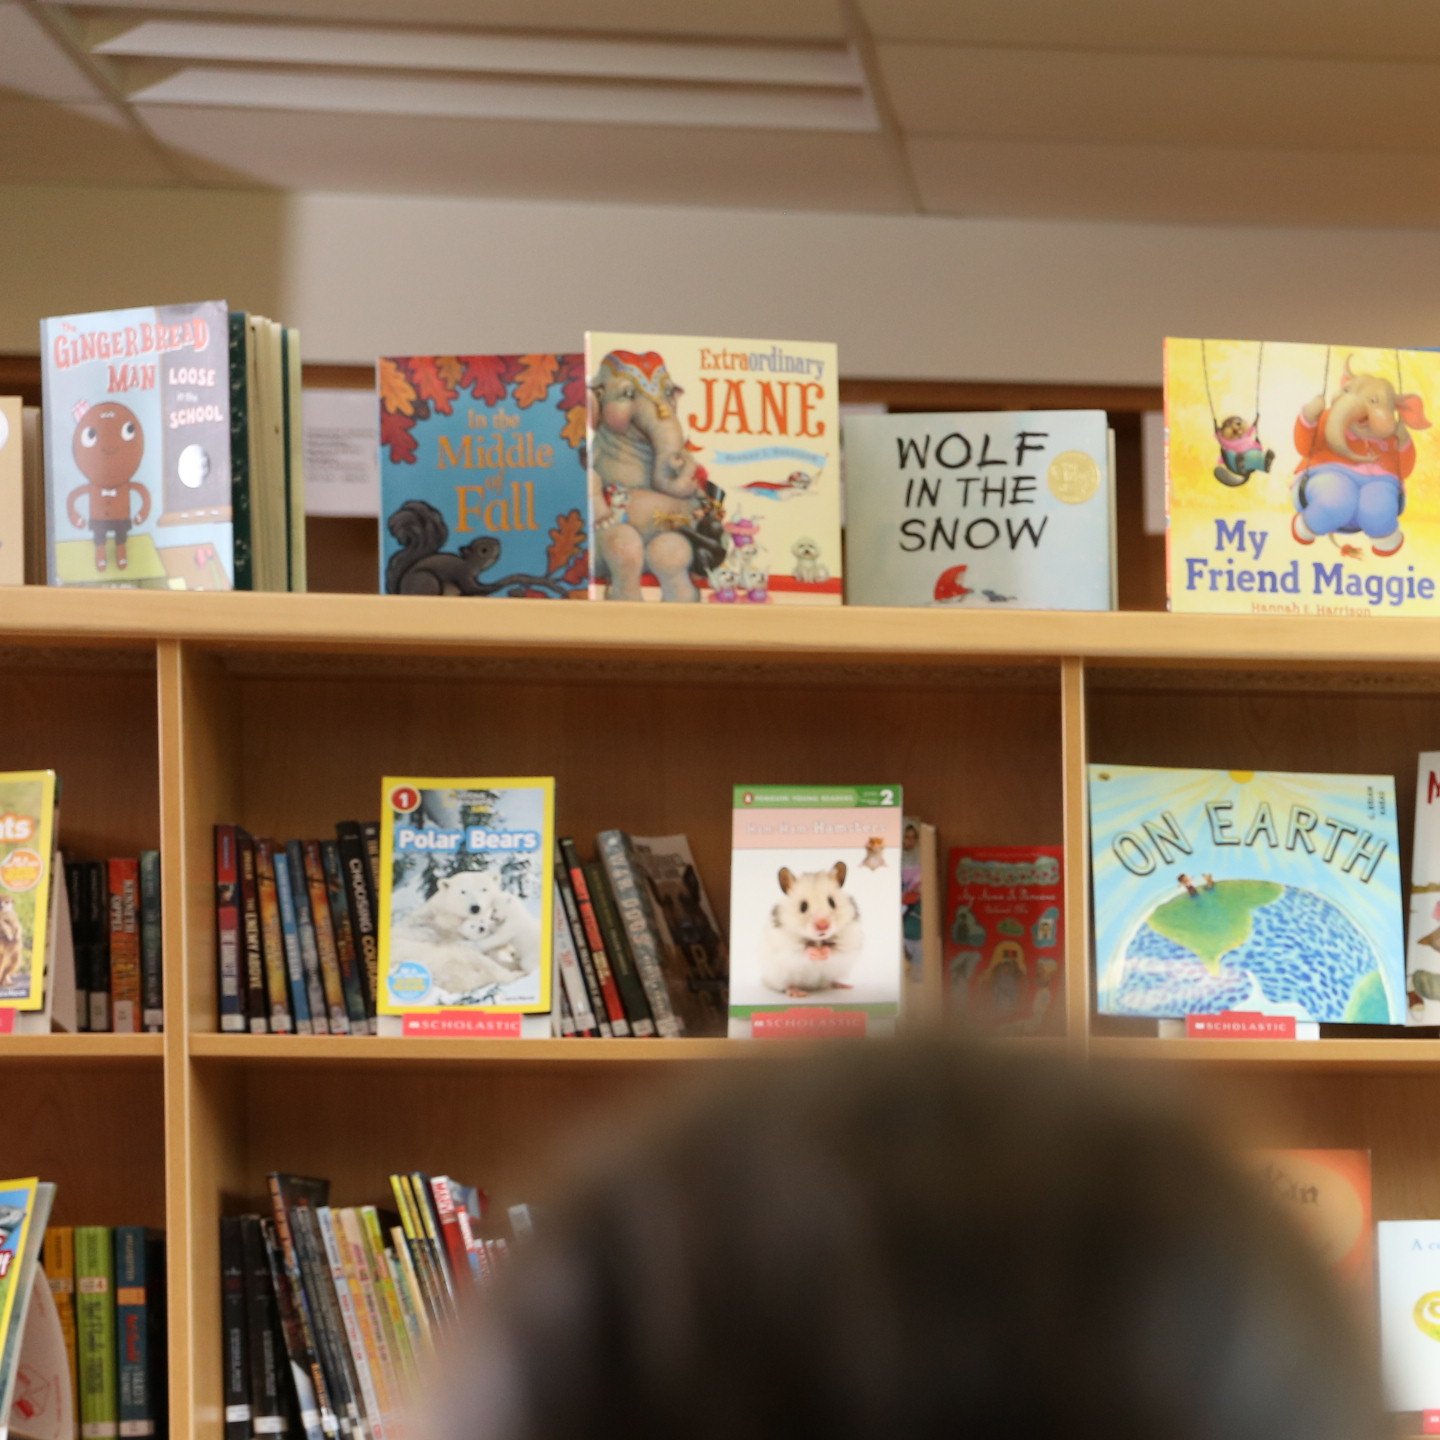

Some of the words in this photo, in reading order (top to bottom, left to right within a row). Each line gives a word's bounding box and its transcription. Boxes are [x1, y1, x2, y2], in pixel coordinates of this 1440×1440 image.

[168, 367, 216, 388] LOOSE
[700, 346, 825, 379] Extraordinary
[168, 404, 224, 430] SCHOOL
[467, 408, 488, 429] In
[493, 407, 521, 430] the
[687, 378, 825, 438] JANE
[436, 431, 555, 469] Middle
[896, 431, 1049, 470] WOLF
[484, 469, 505, 493] of
[905, 477, 941, 508] IN
[956, 476, 1037, 508] THE
[454, 481, 541, 533] Fall
[899, 515, 1048, 552] SNOW
[1214, 518, 1269, 560] My
[1185, 558, 1300, 594] Friend
[1312, 562, 1435, 606] Maggie
[398, 793, 410, 808] 1
[879, 789, 895, 806] 2
[399, 829, 463, 850] Polar
[469, 830, 537, 850] Bears
[1112, 811, 1193, 877] ON
[1205, 800, 1389, 883] EARTH
[349, 857, 373, 933] CHOOSING
[420, 1019, 519, 1031] SCHOLASTIC
[1205, 1022, 1287, 1032] SCHOLASTIC
[1411, 1239, 1423, 1251] A
